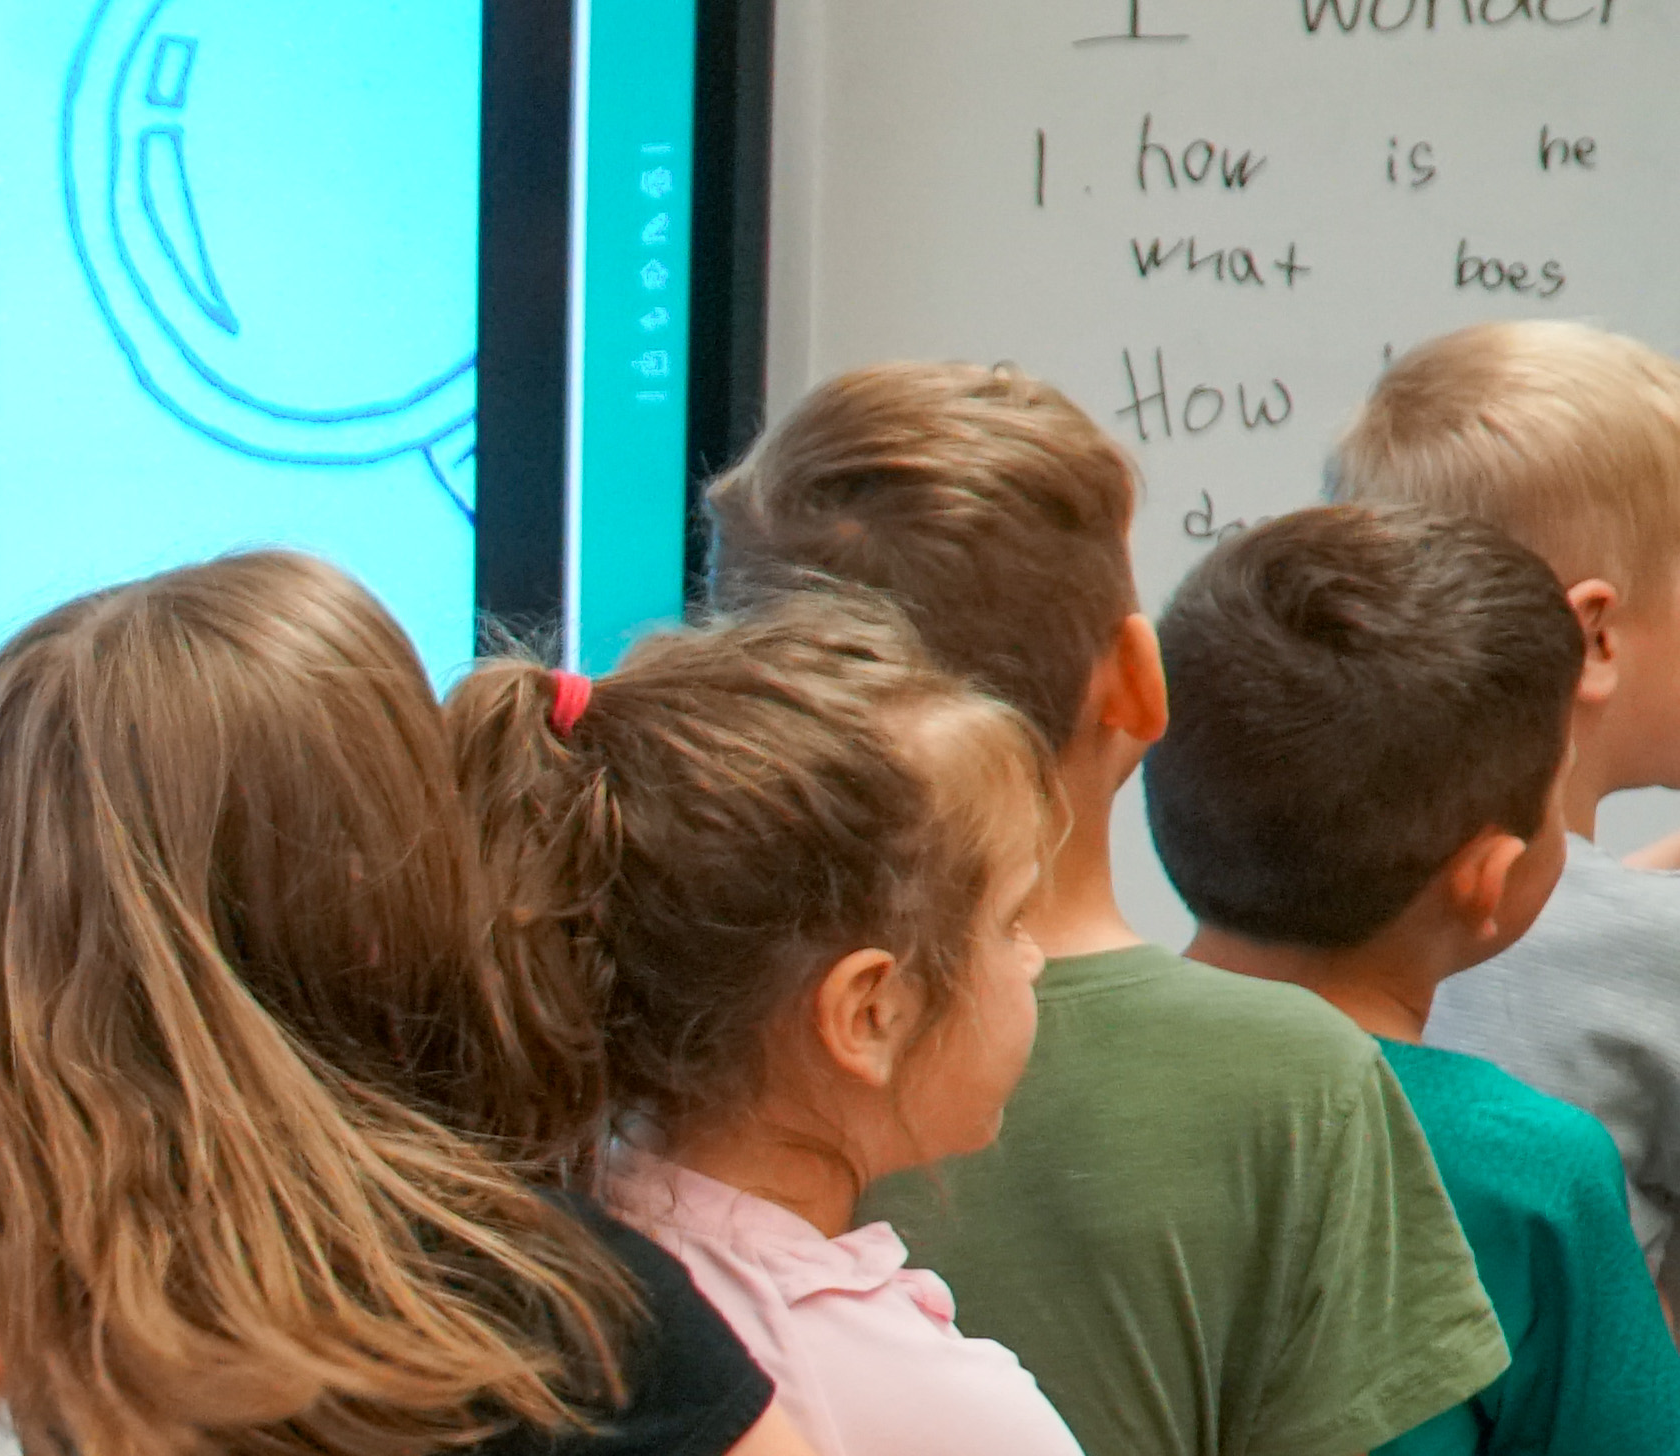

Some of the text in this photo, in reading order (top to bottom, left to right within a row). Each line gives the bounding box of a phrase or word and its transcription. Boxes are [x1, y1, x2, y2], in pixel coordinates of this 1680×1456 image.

[1137, 111, 1268, 191] how
[1385, 136, 1438, 188] is
[1538, 124, 1598, 172] he
[1115, 346, 1294, 442] How
